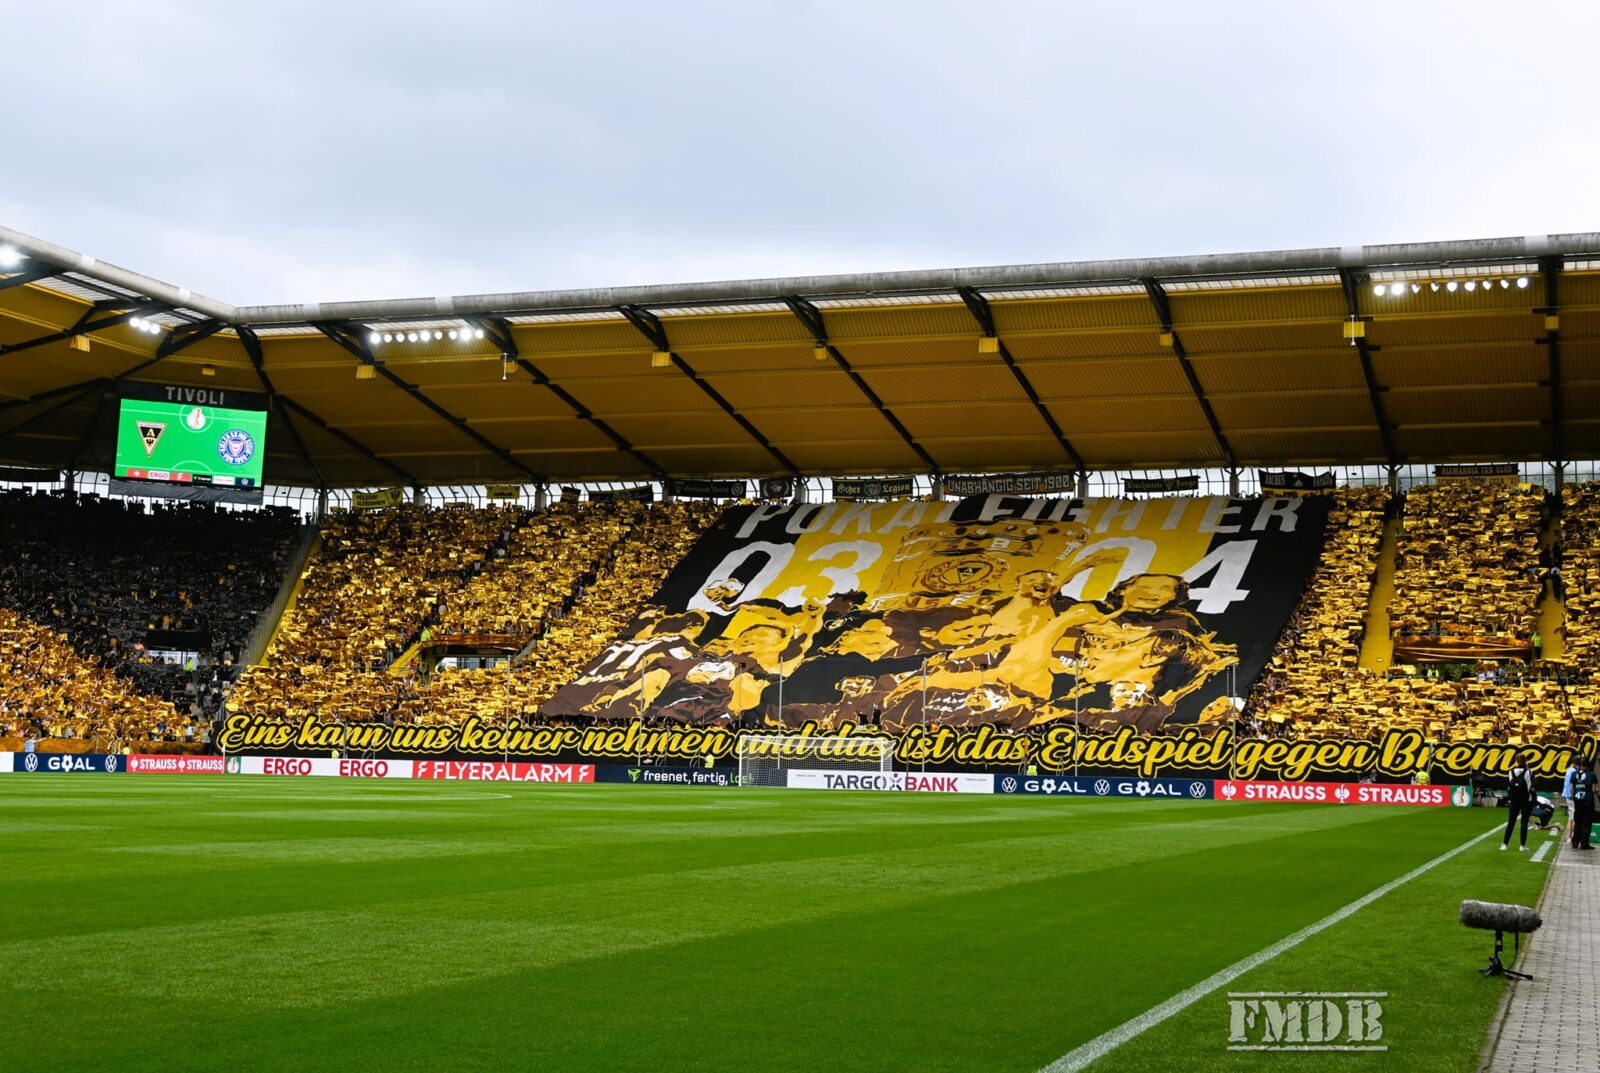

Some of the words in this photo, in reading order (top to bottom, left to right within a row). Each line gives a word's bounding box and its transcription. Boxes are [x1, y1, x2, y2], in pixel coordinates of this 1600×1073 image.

[165, 387, 224, 405] TIVOLI
[149, 471, 168, 479] ERGO
[882, 483, 910, 494] Legion
[948, 478, 1013, 494] UNABHÄNGIG
[1016, 477, 1040, 491] SEIT
[1044, 475, 1069, 489] 1900
[223, 715, 295, 747] Eins
[298, 715, 388, 748] kann
[392, 725, 455, 750] uns
[460, 718, 579, 752] keiner
[580, 719, 734, 755] nehmen
[737, 721, 814, 755] und
[819, 721, 893, 757] das
[907, 724, 952, 760] ist
[956, 723, 1035, 762] das
[1041, 725, 1232, 776] Endspiel
[1236, 738, 1376, 778] gegen
[139, 758, 177, 770] STRAUSS
[187, 758, 223, 771] STRAUSS
[263, 758, 312, 776] ERGO
[339, 760, 388, 777] ERGO
[433, 763, 572, 783] FLYERALARM
[644, 770, 691, 785] freenet,
[692, 772, 728, 786] fertig,
[904, 776, 959, 792] BANK
[1245, 785, 1327, 801] STRAUSS
[1359, 787, 1443, 804] STRAUSS
[1574, 791, 1586, 800] 47
